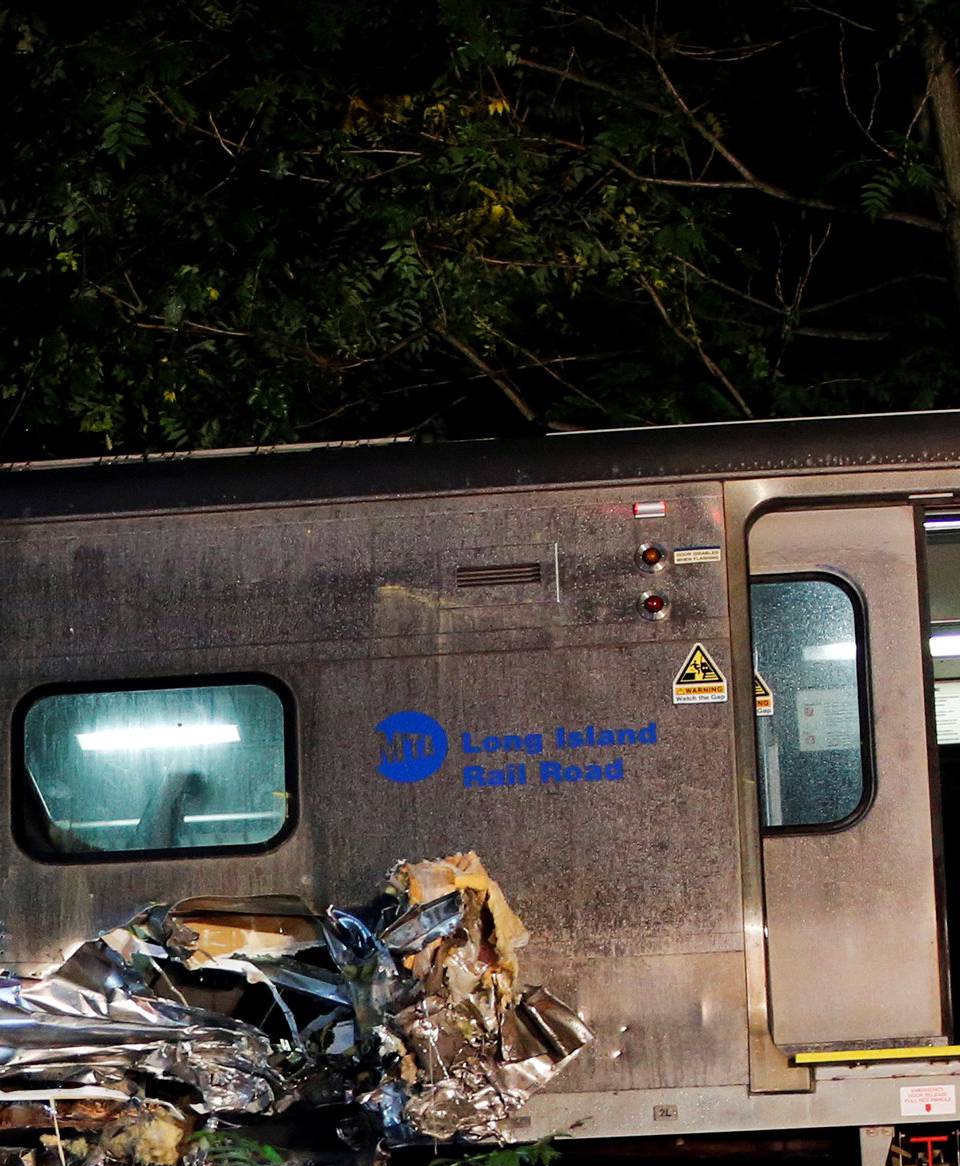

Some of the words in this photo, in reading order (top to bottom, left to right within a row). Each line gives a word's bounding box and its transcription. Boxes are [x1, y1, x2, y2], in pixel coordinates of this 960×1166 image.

[685, 686, 724, 694] WARNING
[711, 693, 726, 701] Gap
[461, 732, 544, 755] Long
[554, 722, 657, 748] Island
[463, 763, 527, 788] Rail
[538, 758, 624, 784] Road
